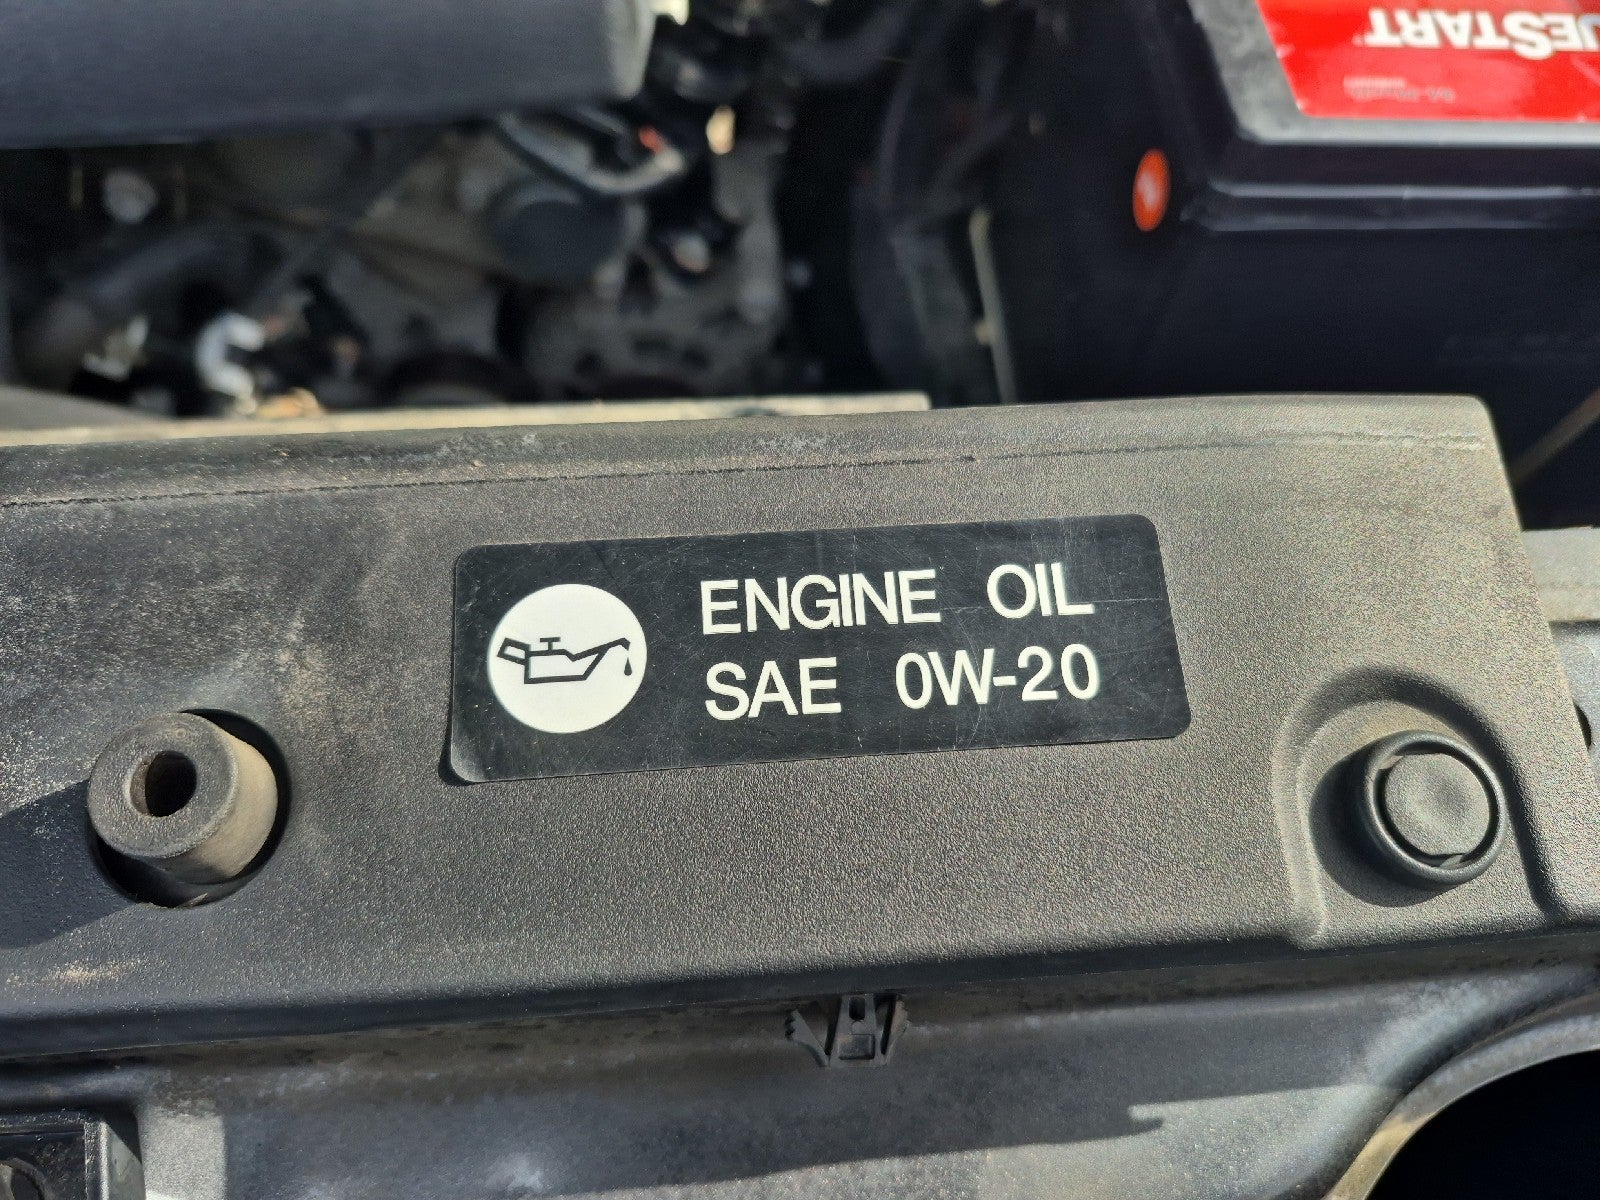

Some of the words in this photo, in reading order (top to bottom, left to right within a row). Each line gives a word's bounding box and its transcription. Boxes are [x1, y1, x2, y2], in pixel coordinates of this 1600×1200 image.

[700, 568, 942, 636] ENGINE
[986, 560, 1096, 620] OIL
[704, 656, 842, 721] SAE
[895, 643, 1101, 710] 0W-20
